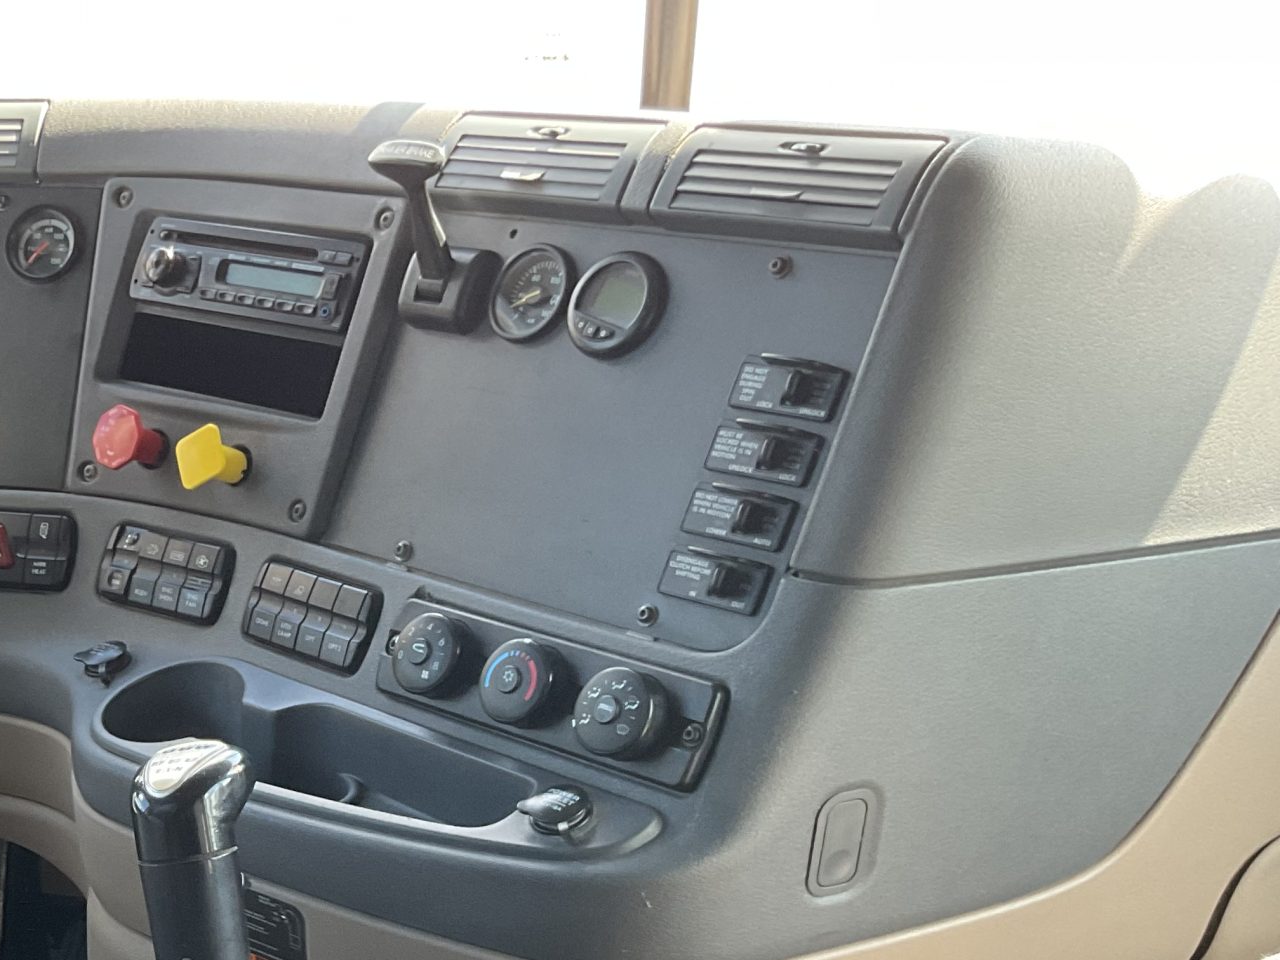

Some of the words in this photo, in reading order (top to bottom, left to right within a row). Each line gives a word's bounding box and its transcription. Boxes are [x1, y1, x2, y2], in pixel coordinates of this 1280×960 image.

[756, 400, 773, 408] LOCK
[799, 407, 825, 417] UNLOCK
[719, 430, 736, 438] MUST
[716, 437, 739, 446] LOCKED
[740, 441, 759, 450] WHEN
[714, 444, 737, 453] VEHICLE
[711, 450, 736, 460] MOTION
[728, 464, 753, 473] UNLOCK
[778, 473, 796, 481] LOCK
[695, 491, 705, 499] DO
[693, 499, 712, 507] WHEN
[712, 502, 735, 513] VEHICLE
[706, 508, 731, 519] MOTION
[705, 527, 727, 536] LOWER
[753, 537, 772, 546] AUTO
[669, 560, 690, 570] CLUTCH
[691, 565, 712, 576] BEFORE
[675, 569, 700, 580] SHIFTING
[277, 630, 291, 638] LAMP
[408, 626, 415, 636] 2
